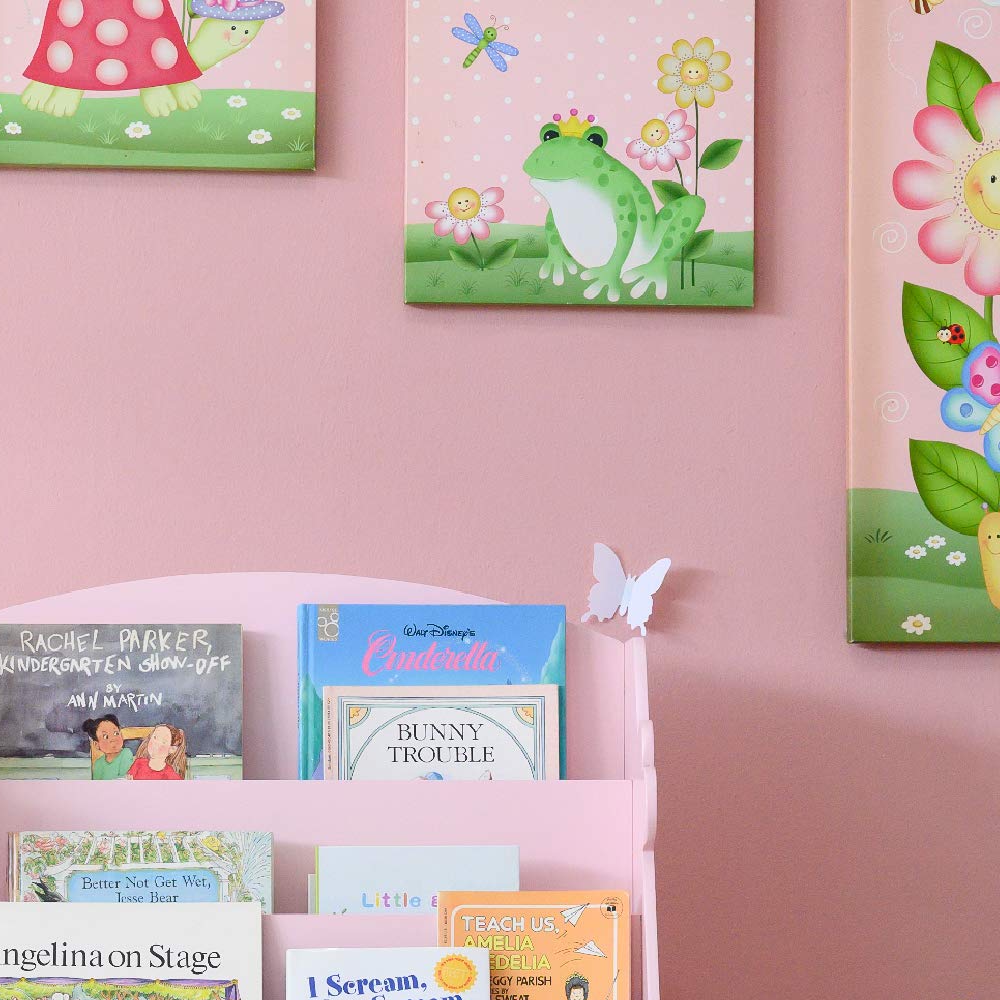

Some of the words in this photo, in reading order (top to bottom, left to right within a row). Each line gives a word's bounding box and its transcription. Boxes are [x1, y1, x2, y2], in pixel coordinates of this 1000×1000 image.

[20, 629, 104, 653] RACHEL
[119, 626, 213, 655] PARKER,
[403, 623, 428, 638] Walt
[427, 623, 476, 641] Disney's
[362, 629, 502, 677] Cinderella
[138, 654, 232, 675] SHOW-OFF
[105, 683, 122, 694] BY
[66, 692, 98, 711] ANN
[103, 692, 163, 712] MARTIN
[396, 723, 485, 741] BUNNY
[387, 746, 496, 763] TROUBLE
[81, 876, 121, 890] Better
[125, 876, 149, 890] Not
[154, 875, 178, 889] Get
[182, 875, 211, 890] Wet,
[115, 892, 142, 903] Jesse
[149, 892, 179, 903] Bear
[361, 892, 421, 908] Little
[461, 915, 525, 933] TEACH
[530, 916, 560, 934] US,
[463, 935, 535, 951] AMELIA
[107, 948, 142, 968] on
[149, 944, 222, 975] Stage
[489, 954, 551, 970] EDELIA
[306, 976, 318, 999] I
[326, 973, 428, 997] Scream,
[490, 976, 513, 986] GGY
[516, 975, 552, 986] PARISH
